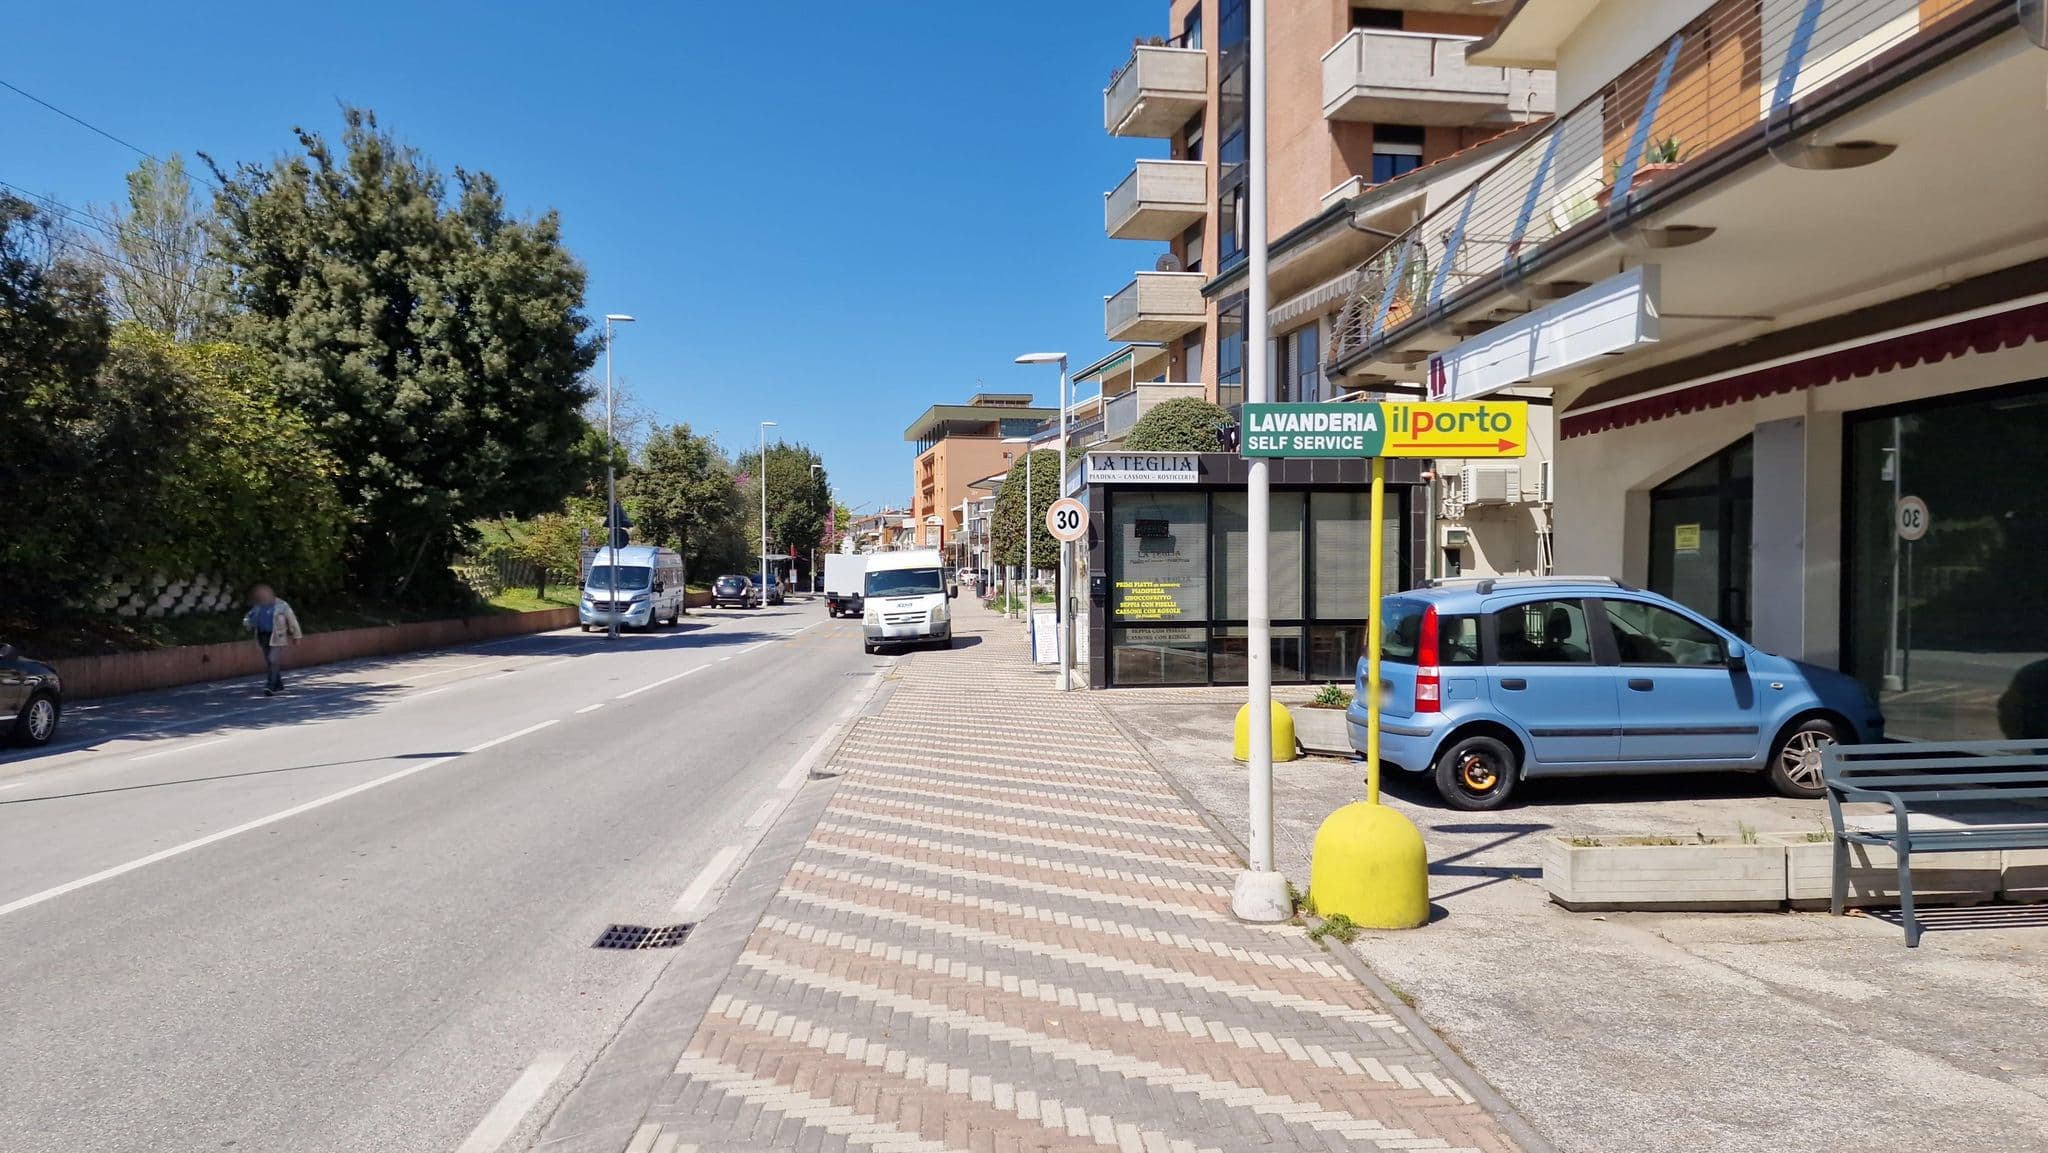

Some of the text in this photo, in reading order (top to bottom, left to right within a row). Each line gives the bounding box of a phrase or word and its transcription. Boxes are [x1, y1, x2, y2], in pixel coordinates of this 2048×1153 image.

[1250, 413, 1377, 432] LAVANDERIA
[1248, 436, 1363, 450] SELF SERVICE
[1092, 456, 1193, 471] LA TEGLIA
[1057, 510, 1079, 529] 30
